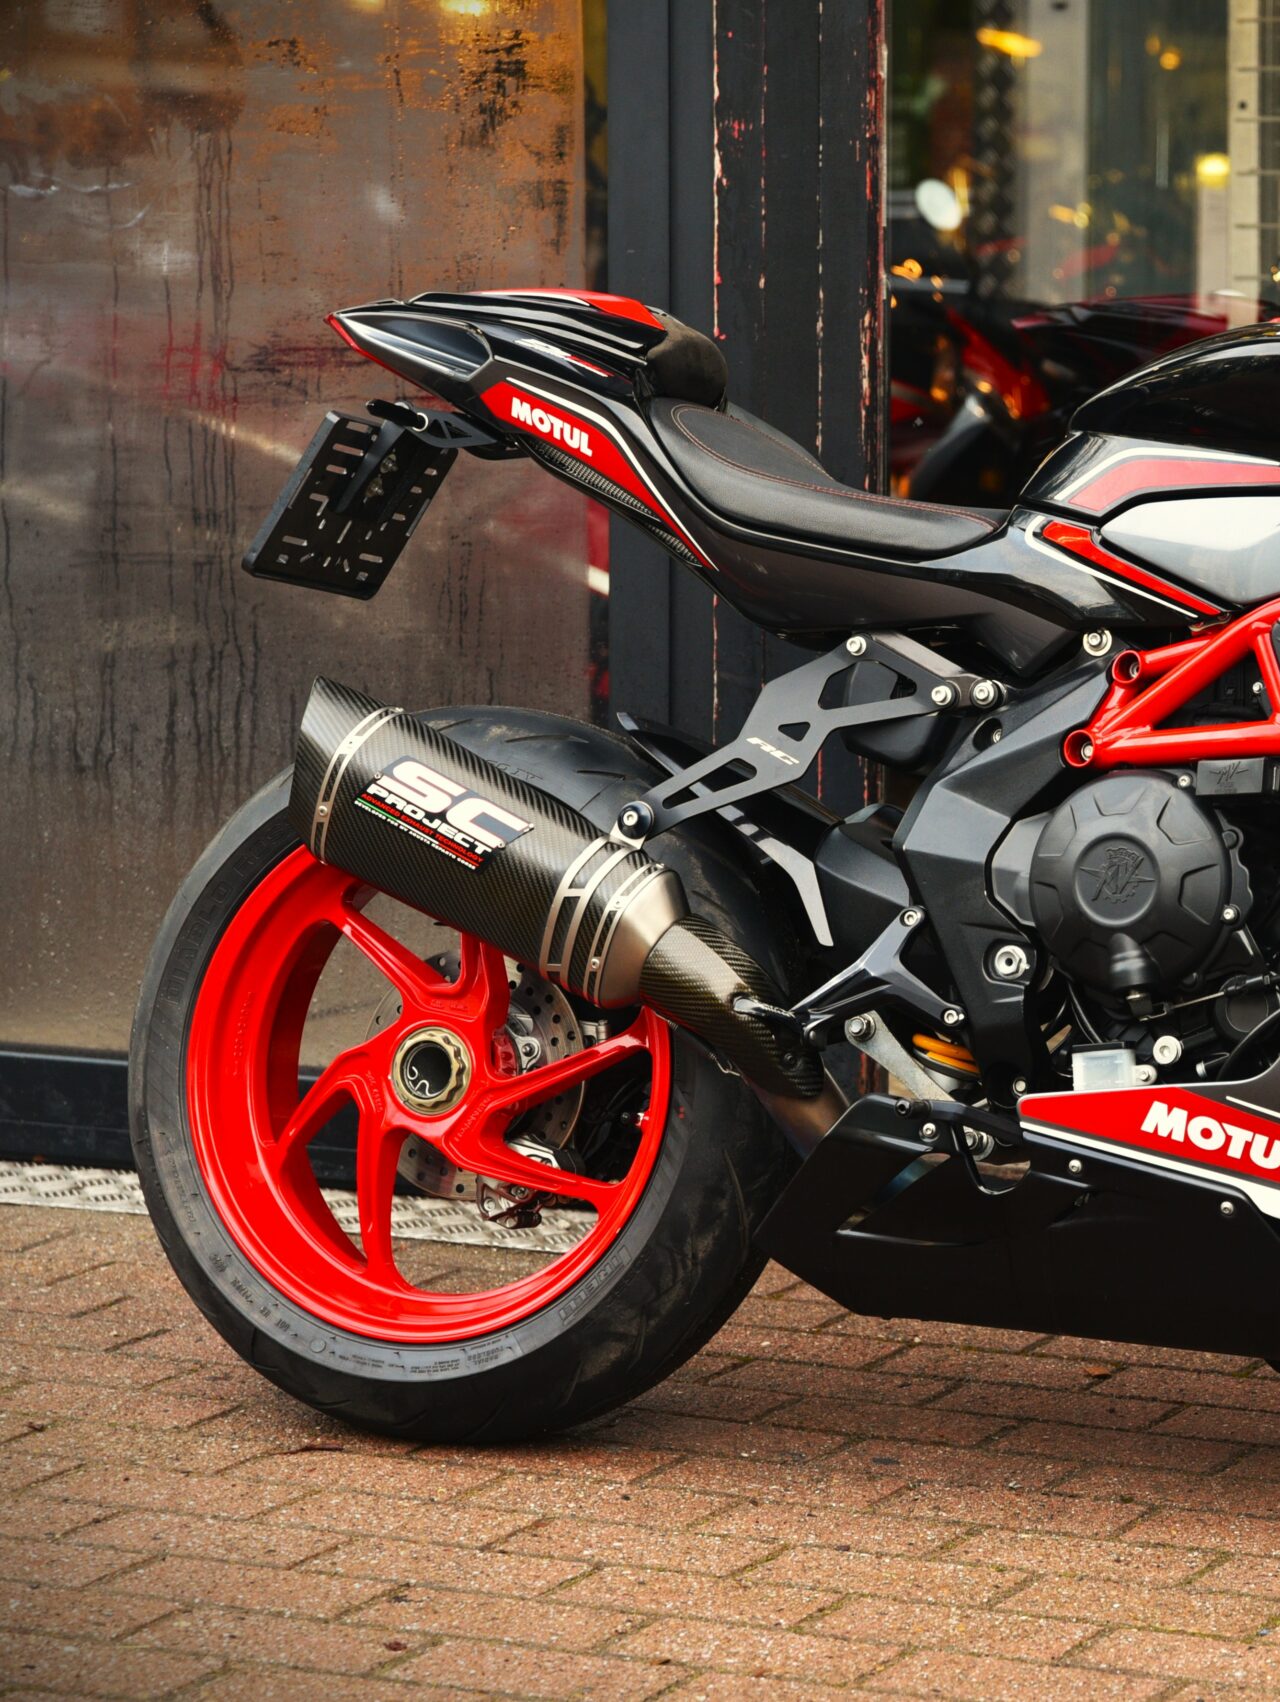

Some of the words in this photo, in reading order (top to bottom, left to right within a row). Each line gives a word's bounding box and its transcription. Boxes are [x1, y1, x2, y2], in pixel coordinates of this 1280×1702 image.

[511, 396, 593, 457] MOTUL
[360, 793, 401, 818] ADVANCED
[400, 813, 435, 836] EXHAUST
[434, 832, 485, 863] TECHNOLOGY
[366, 783, 492, 855] PROJECT
[376, 761, 534, 849] SC
[559, 1244, 633, 1325] PIRELLI
